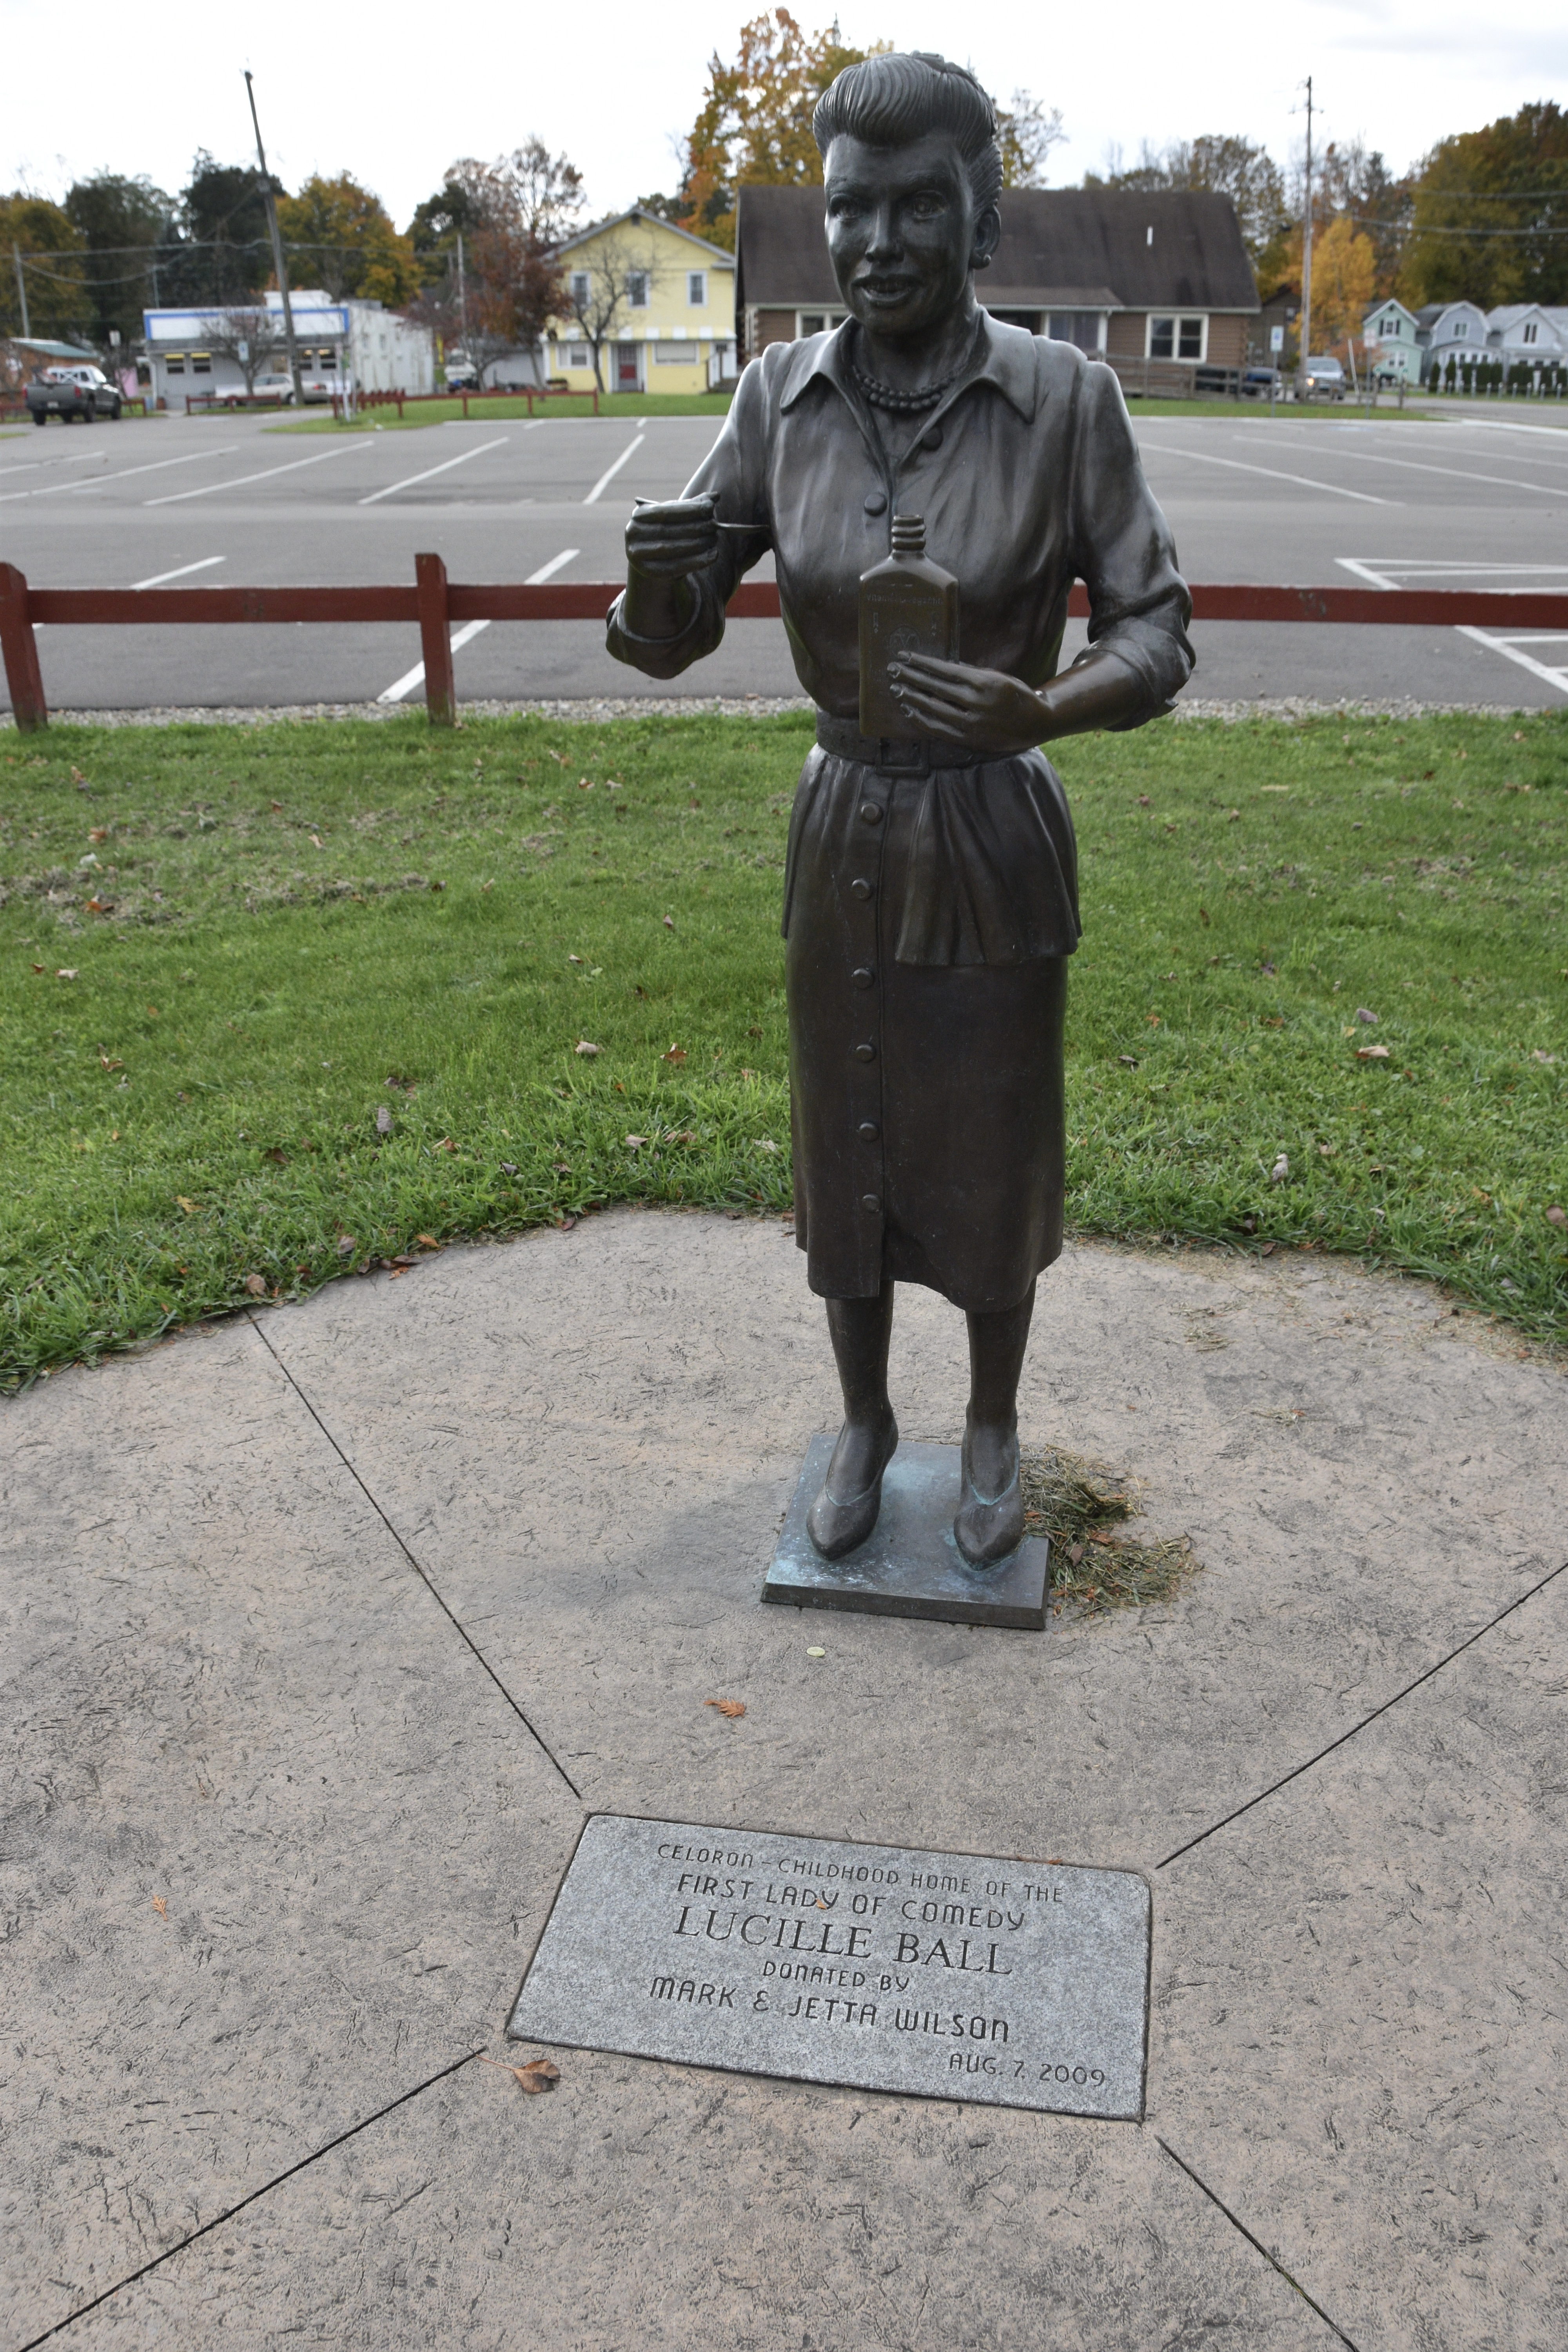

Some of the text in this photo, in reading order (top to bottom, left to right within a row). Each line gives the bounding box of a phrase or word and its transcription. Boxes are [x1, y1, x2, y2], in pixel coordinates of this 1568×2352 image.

[658, 1844, 753, 1868] CELORON
[778, 1858, 899, 1884] CHILDHOOD
[911, 1872, 971, 1893] HOME
[986, 1880, 1011, 1897] OF
[1024, 1884, 1063, 1903] THE
[677, 1873, 1025, 1931] FIRST LADY OF COMEDY
[672, 1906, 1013, 1975] LUCILLE BALL
[763, 1960, 909, 1992] DONATED BY
[650, 1976, 1009, 2042] MARK & JETTA WILSON
[949, 2053, 1004, 2076] AUG.
[1039, 2063, 1105, 2087] 2009
